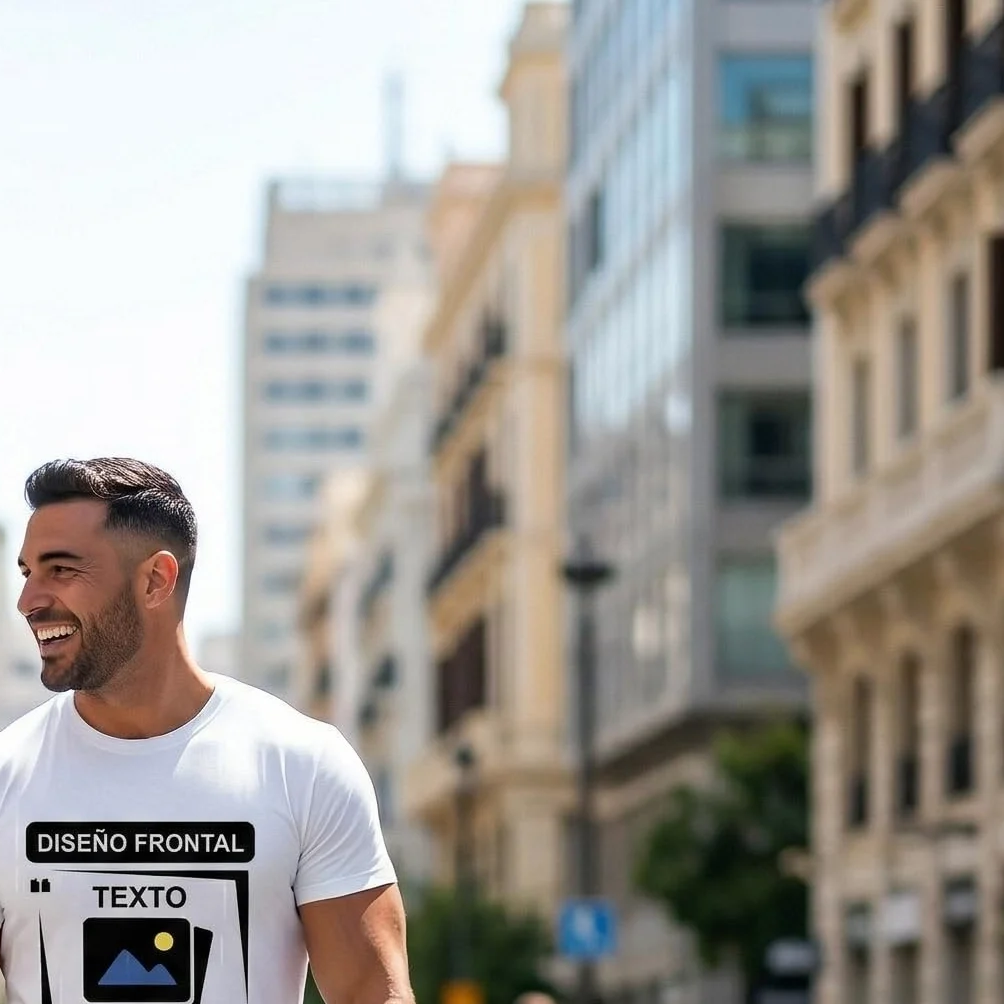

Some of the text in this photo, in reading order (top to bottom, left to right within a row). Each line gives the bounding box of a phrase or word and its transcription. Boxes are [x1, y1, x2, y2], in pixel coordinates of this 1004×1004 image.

[38, 829, 245, 853] DISEÑO FRONTAL
[92, 886, 187, 908] TEXTO
